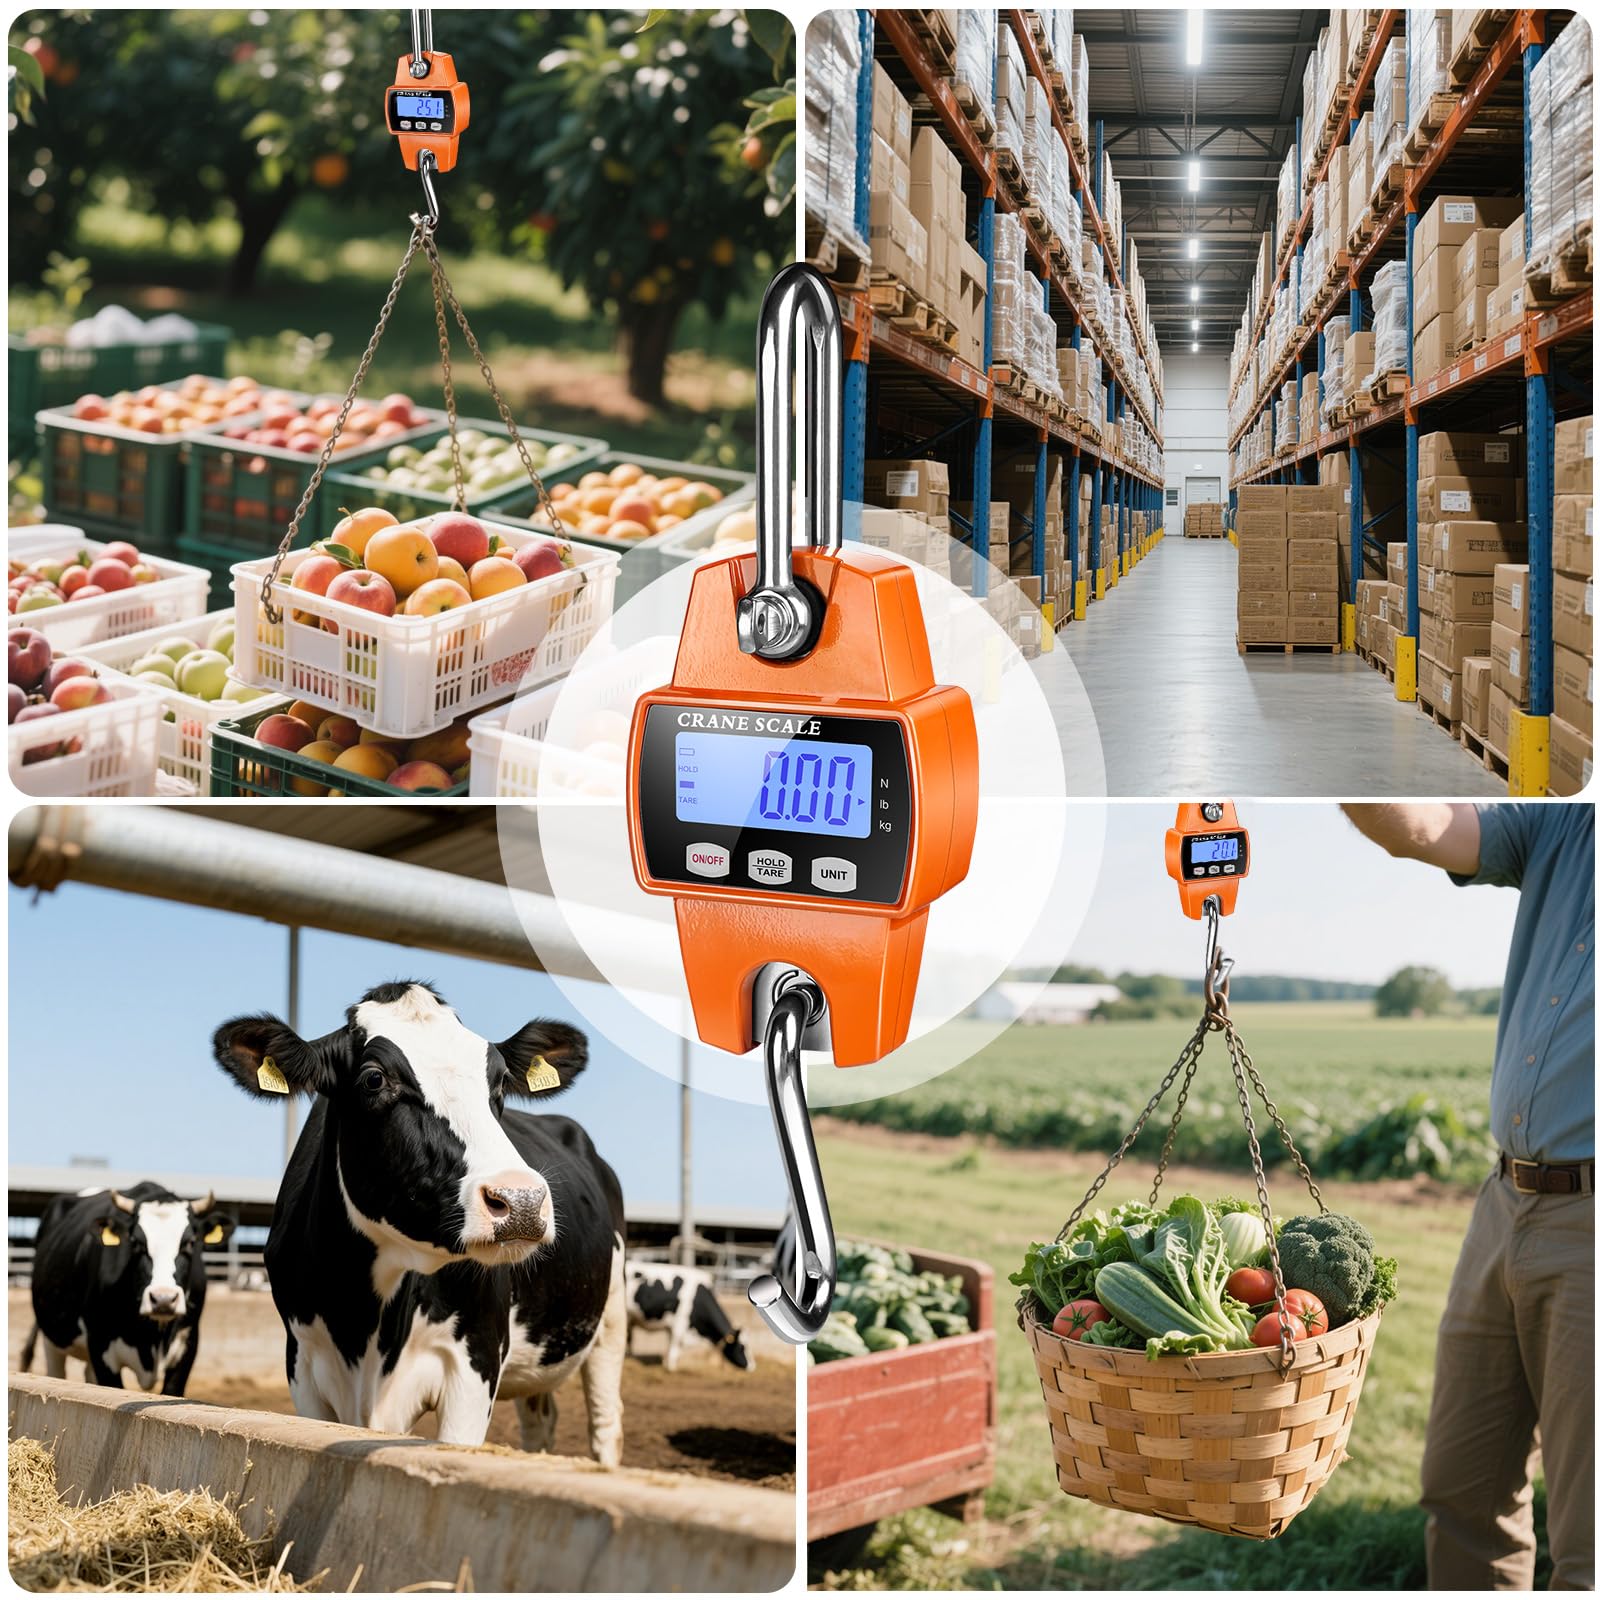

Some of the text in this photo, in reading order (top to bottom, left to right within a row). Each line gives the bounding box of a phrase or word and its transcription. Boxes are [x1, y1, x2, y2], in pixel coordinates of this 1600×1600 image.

[677, 712, 822, 736] CRANE SCALE
[678, 765, 698, 773] HOLD
[759, 750, 856, 826] 0.00
[880, 778, 889, 788] N
[678, 796, 698, 805] TARE
[879, 799, 889, 809] lb
[879, 820, 892, 832] kg
[691, 853, 725, 867] ON/OFF
[756, 857, 786, 868] HOLD
[756, 867, 785, 878] TARE
[820, 869, 848, 881] UNIT
